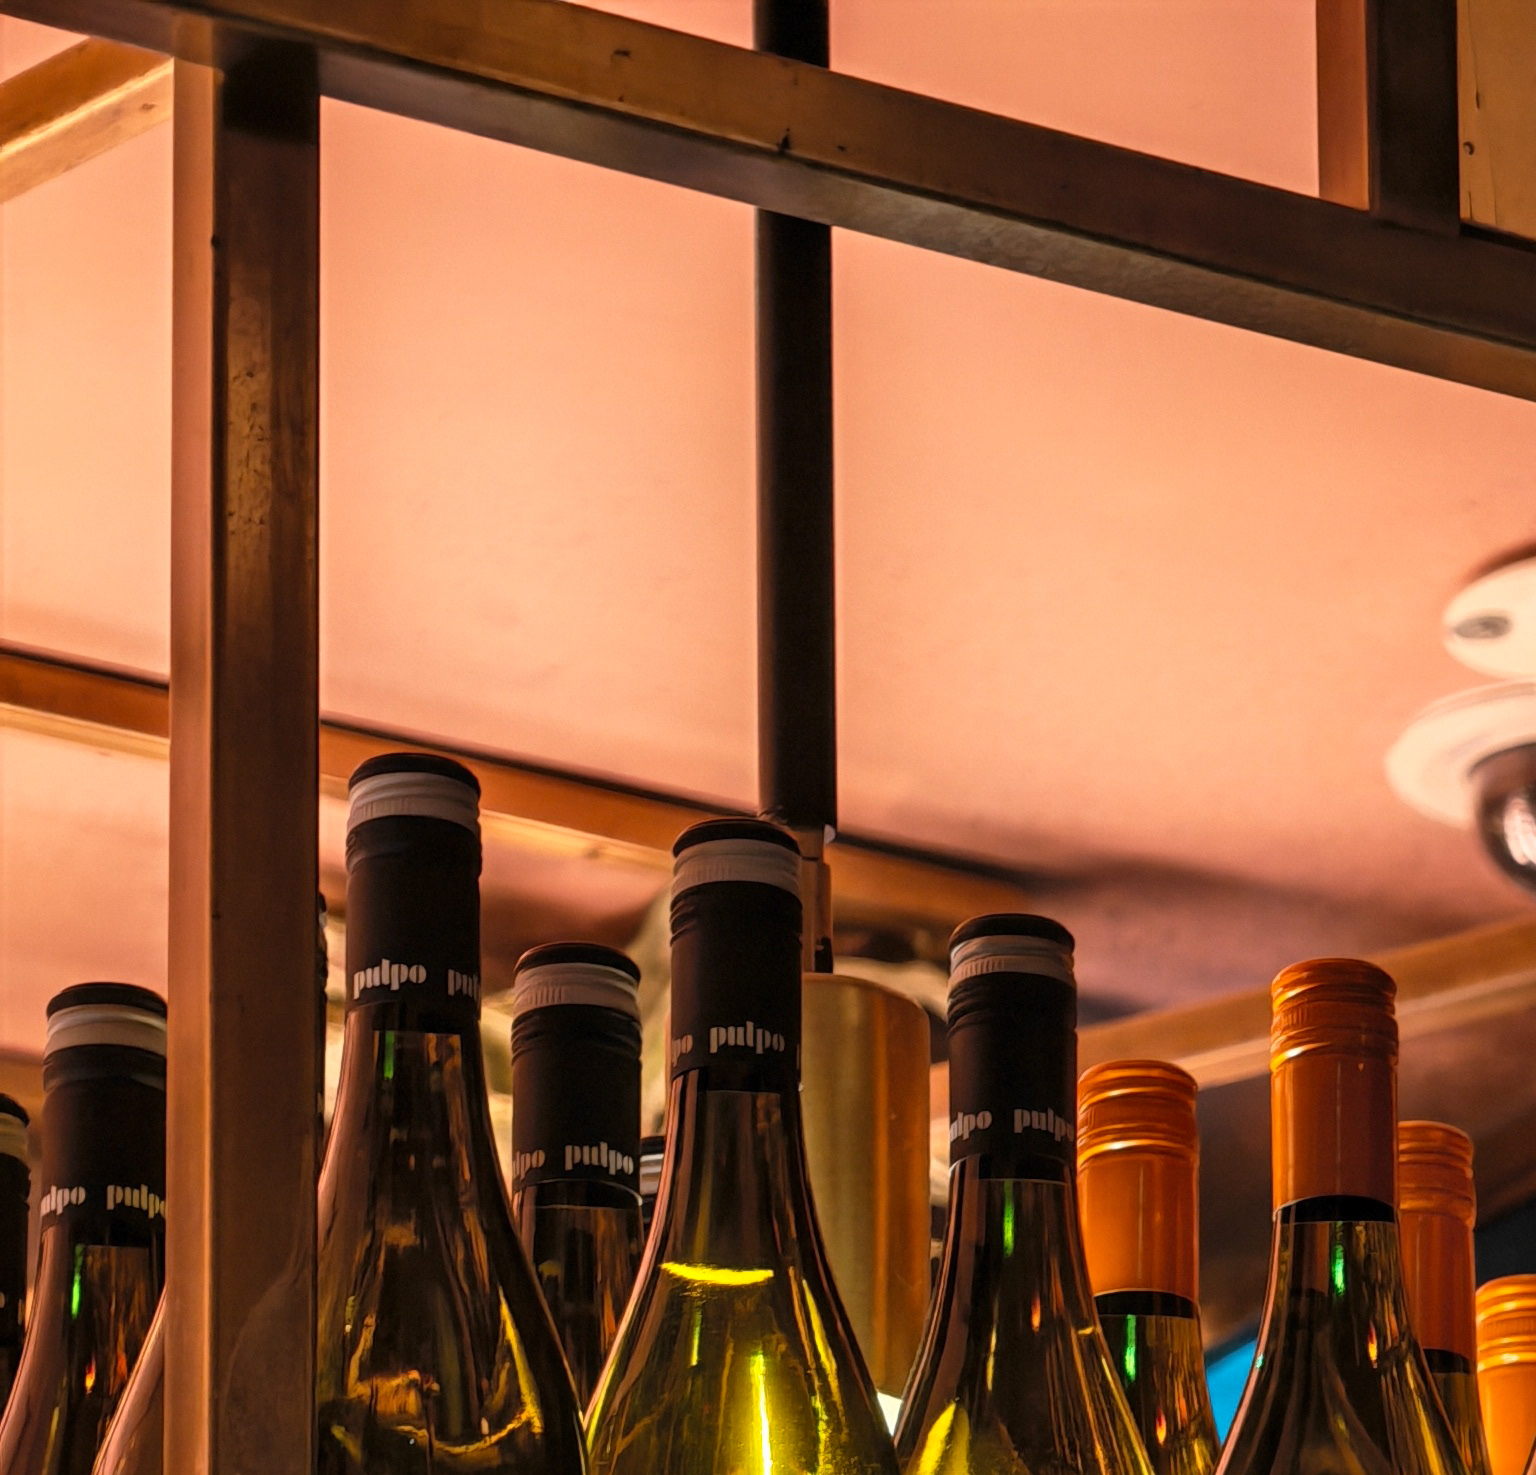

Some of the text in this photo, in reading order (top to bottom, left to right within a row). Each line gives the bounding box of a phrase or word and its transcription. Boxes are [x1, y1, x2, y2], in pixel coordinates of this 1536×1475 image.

[353, 958, 480, 1001] pulpo pul
[709, 1020, 786, 1055] pulpo
[564, 1141, 635, 1176] pulpo
